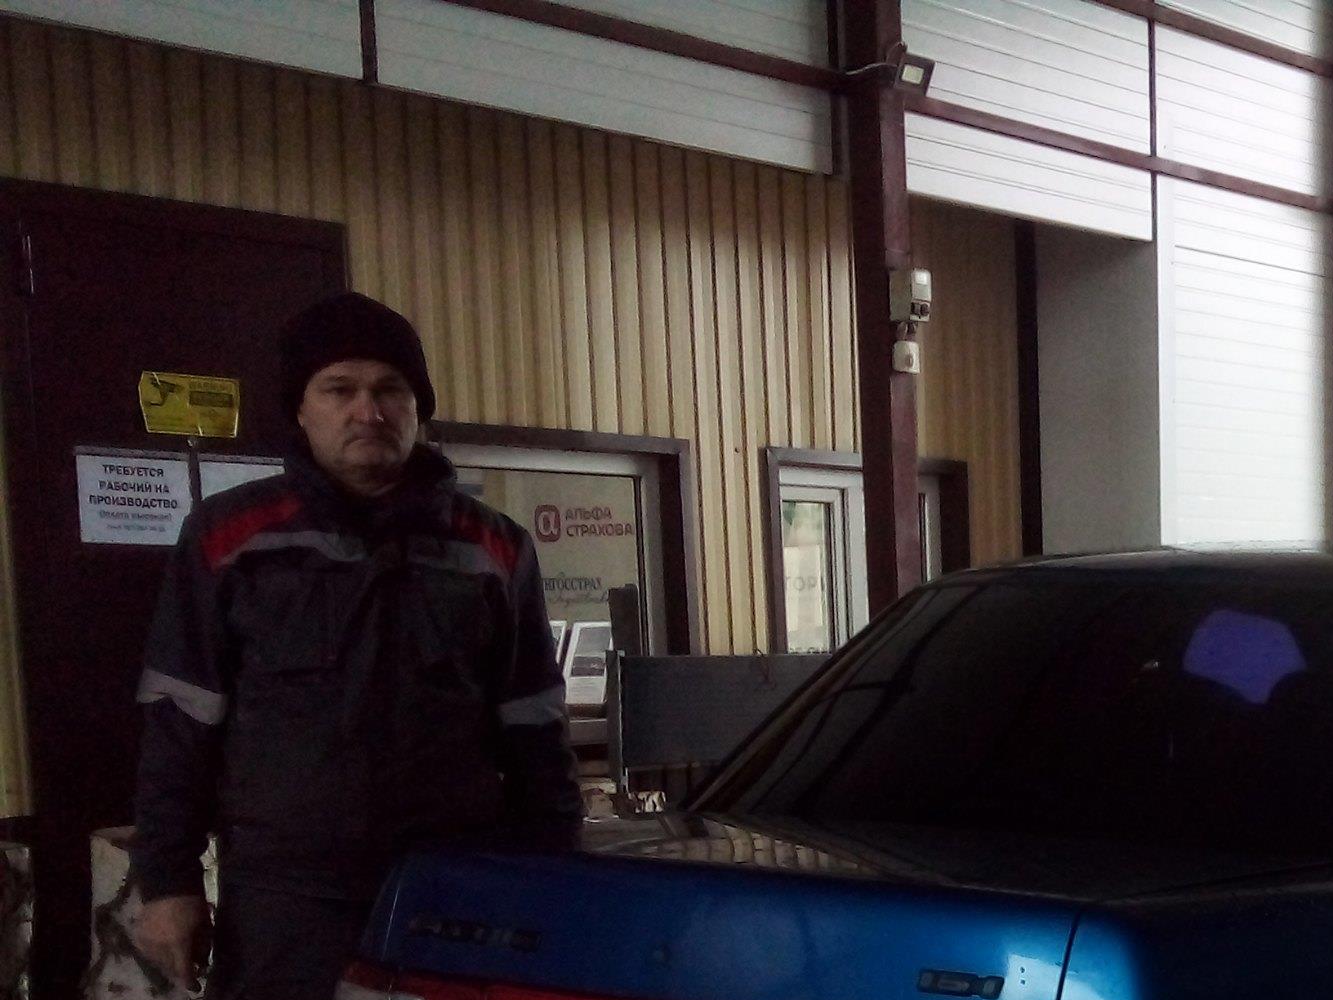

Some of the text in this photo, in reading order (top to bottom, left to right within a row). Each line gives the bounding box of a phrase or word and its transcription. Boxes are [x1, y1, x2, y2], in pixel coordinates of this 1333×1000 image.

[102, 464, 164, 477] ТРЕБУЕТСЯ
[98, 480, 170, 493] РАБОЧИЙ НА
[88, 494, 178, 509] ПРОИЗВОДСТВО
[565, 506, 612, 521] АЛЬФА
